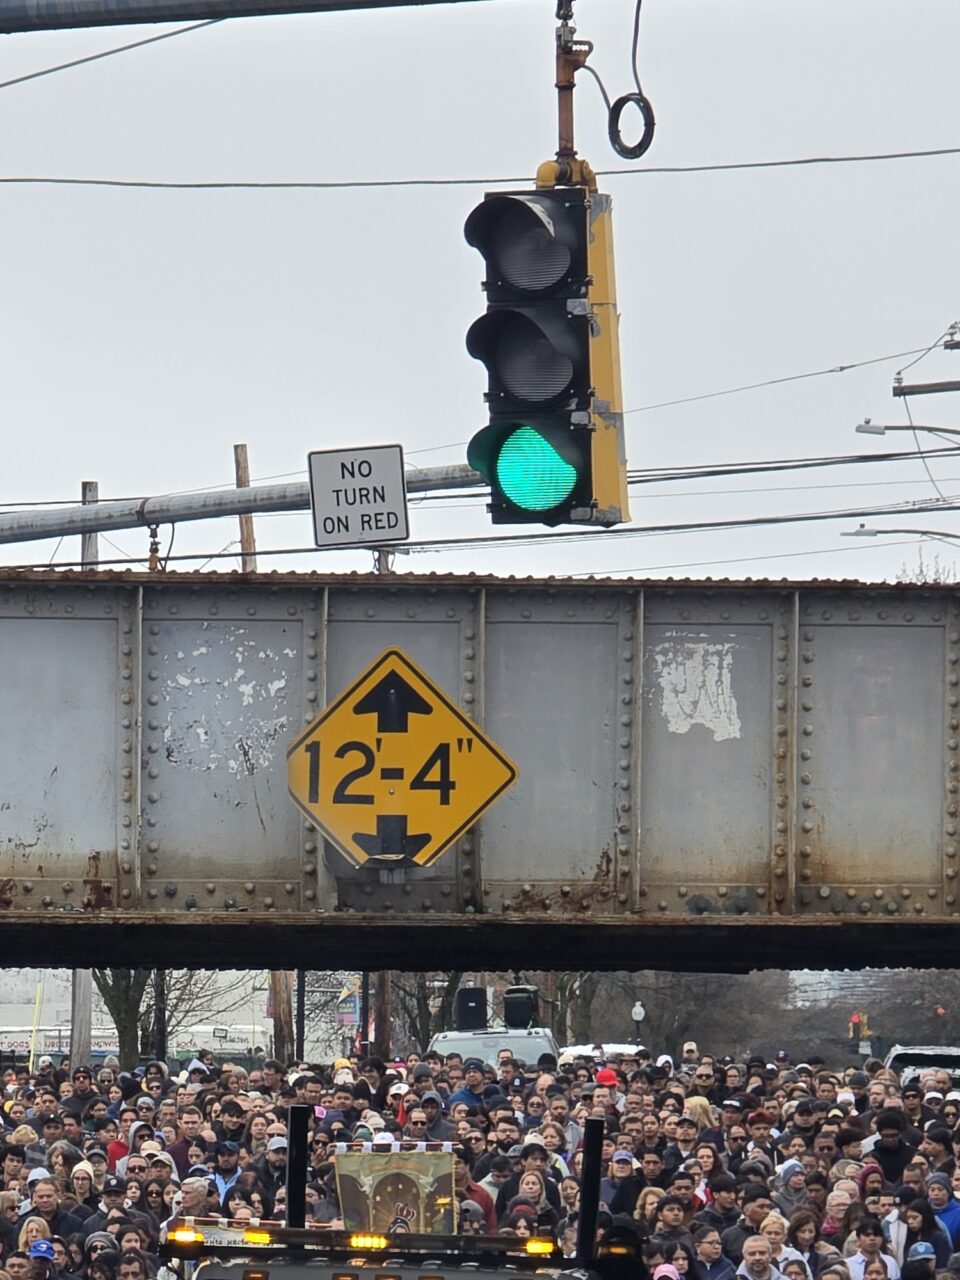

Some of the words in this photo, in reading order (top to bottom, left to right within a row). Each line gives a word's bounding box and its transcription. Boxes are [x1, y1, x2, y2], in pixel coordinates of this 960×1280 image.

[340, 460, 372, 480] NO
[332, 485, 385, 507] TURN
[323, 515, 349, 534] ON
[361, 511, 399, 531] RED
